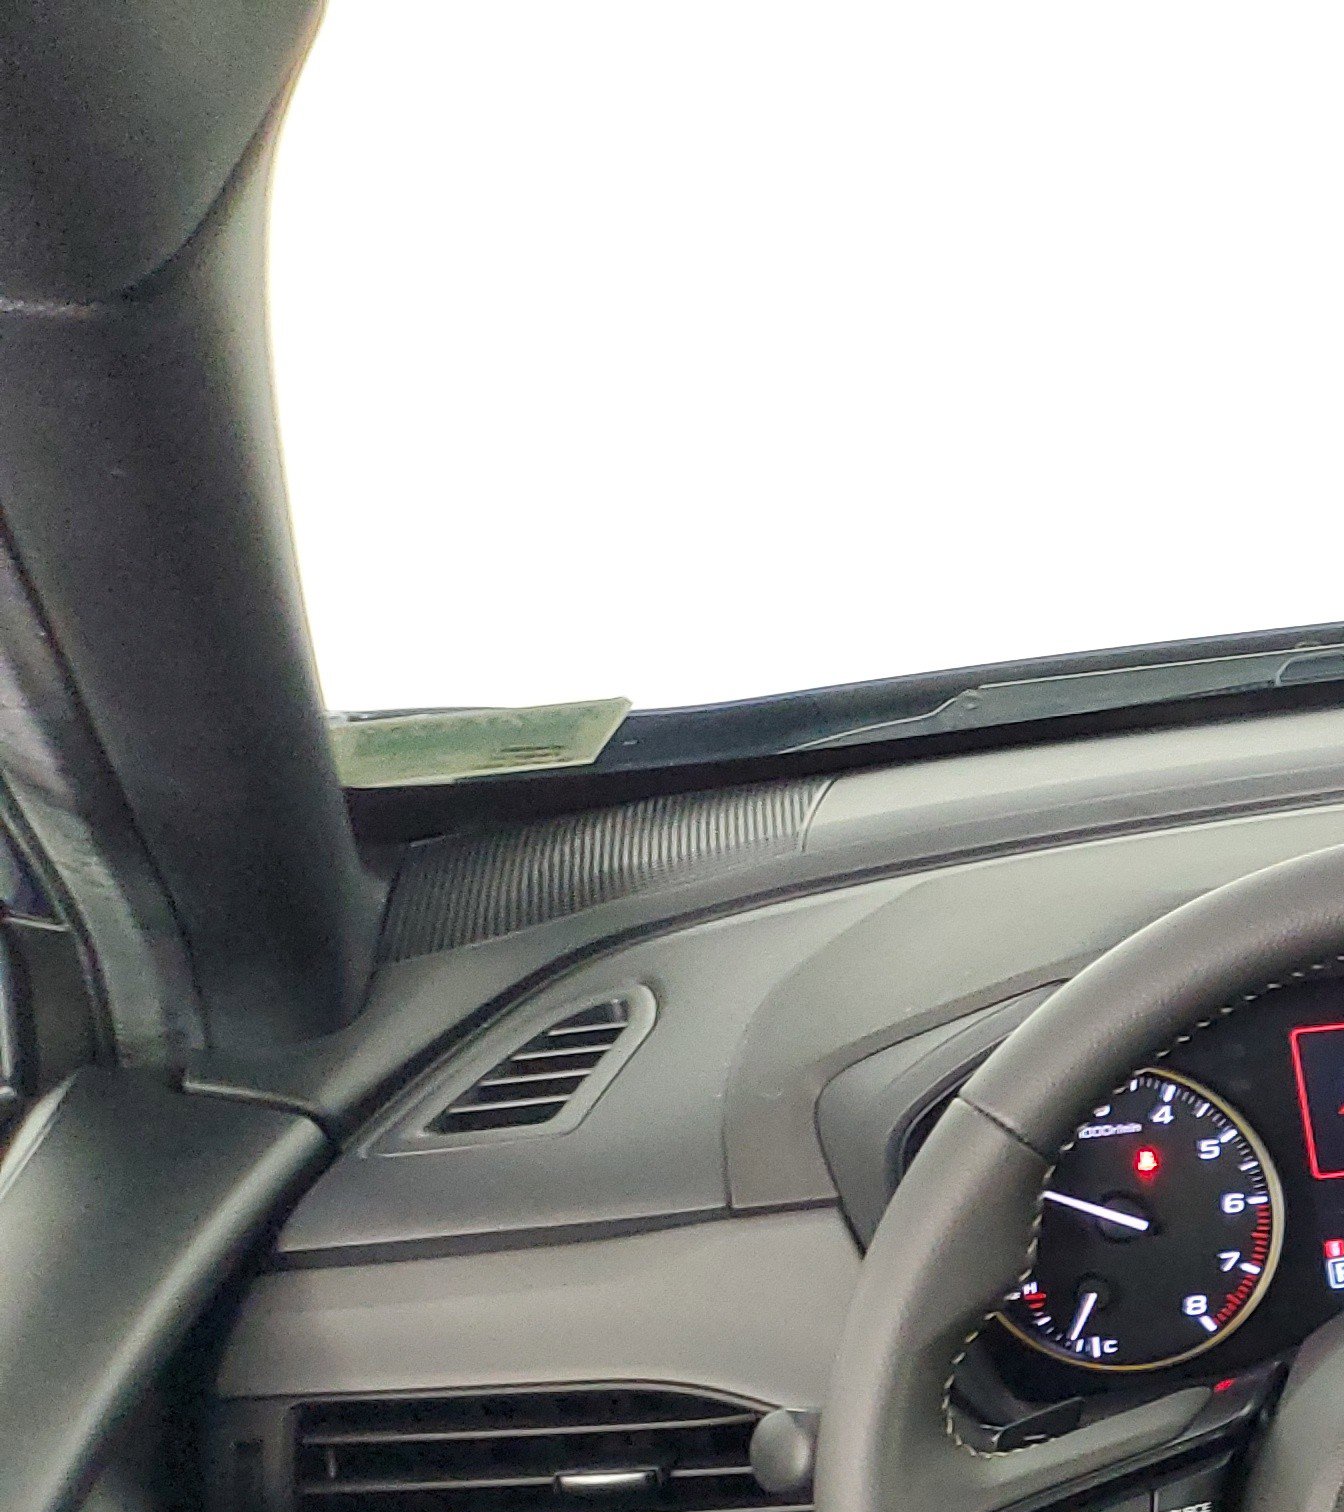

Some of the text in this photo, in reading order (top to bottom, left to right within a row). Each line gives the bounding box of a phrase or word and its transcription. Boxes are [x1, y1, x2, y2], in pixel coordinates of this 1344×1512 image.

[1152, 1105, 1174, 1125] 4
[1198, 1139, 1221, 1160] 5
[1221, 1193, 1245, 1214] 6
[1217, 1251, 1241, 1273] 7
[1183, 1295, 1208, 1316] 8
